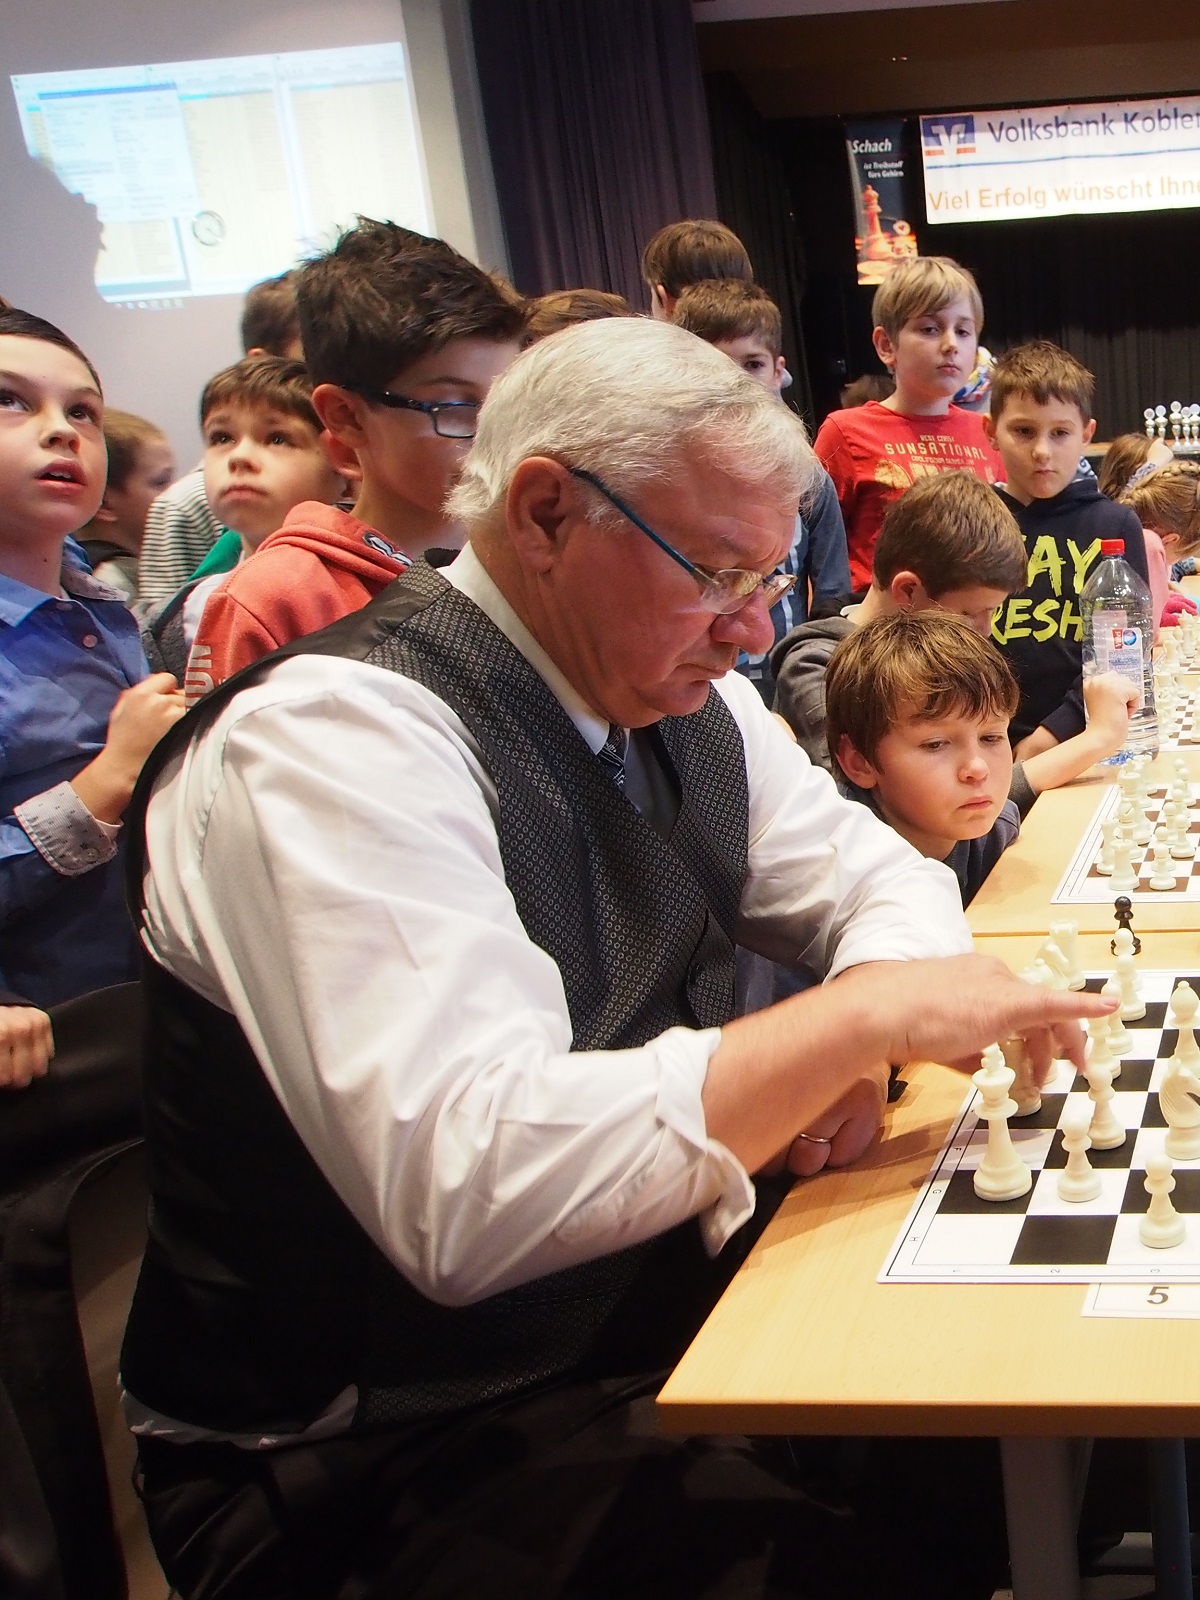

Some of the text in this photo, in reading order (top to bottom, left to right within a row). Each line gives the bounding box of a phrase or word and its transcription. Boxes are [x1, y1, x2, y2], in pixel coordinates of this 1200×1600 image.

[987, 112, 1115, 143] Volksbank
[852, 138, 893, 154] Schach
[928, 189, 969, 211] Viel
[979, 185, 1047, 210] Erfolg
[1054, 178, 1152, 203] wünscht
[884, 442, 987, 461] SUNSATIONAL
[1021, 535, 1102, 597] AY
[1146, 1286, 1170, 1305] 5
